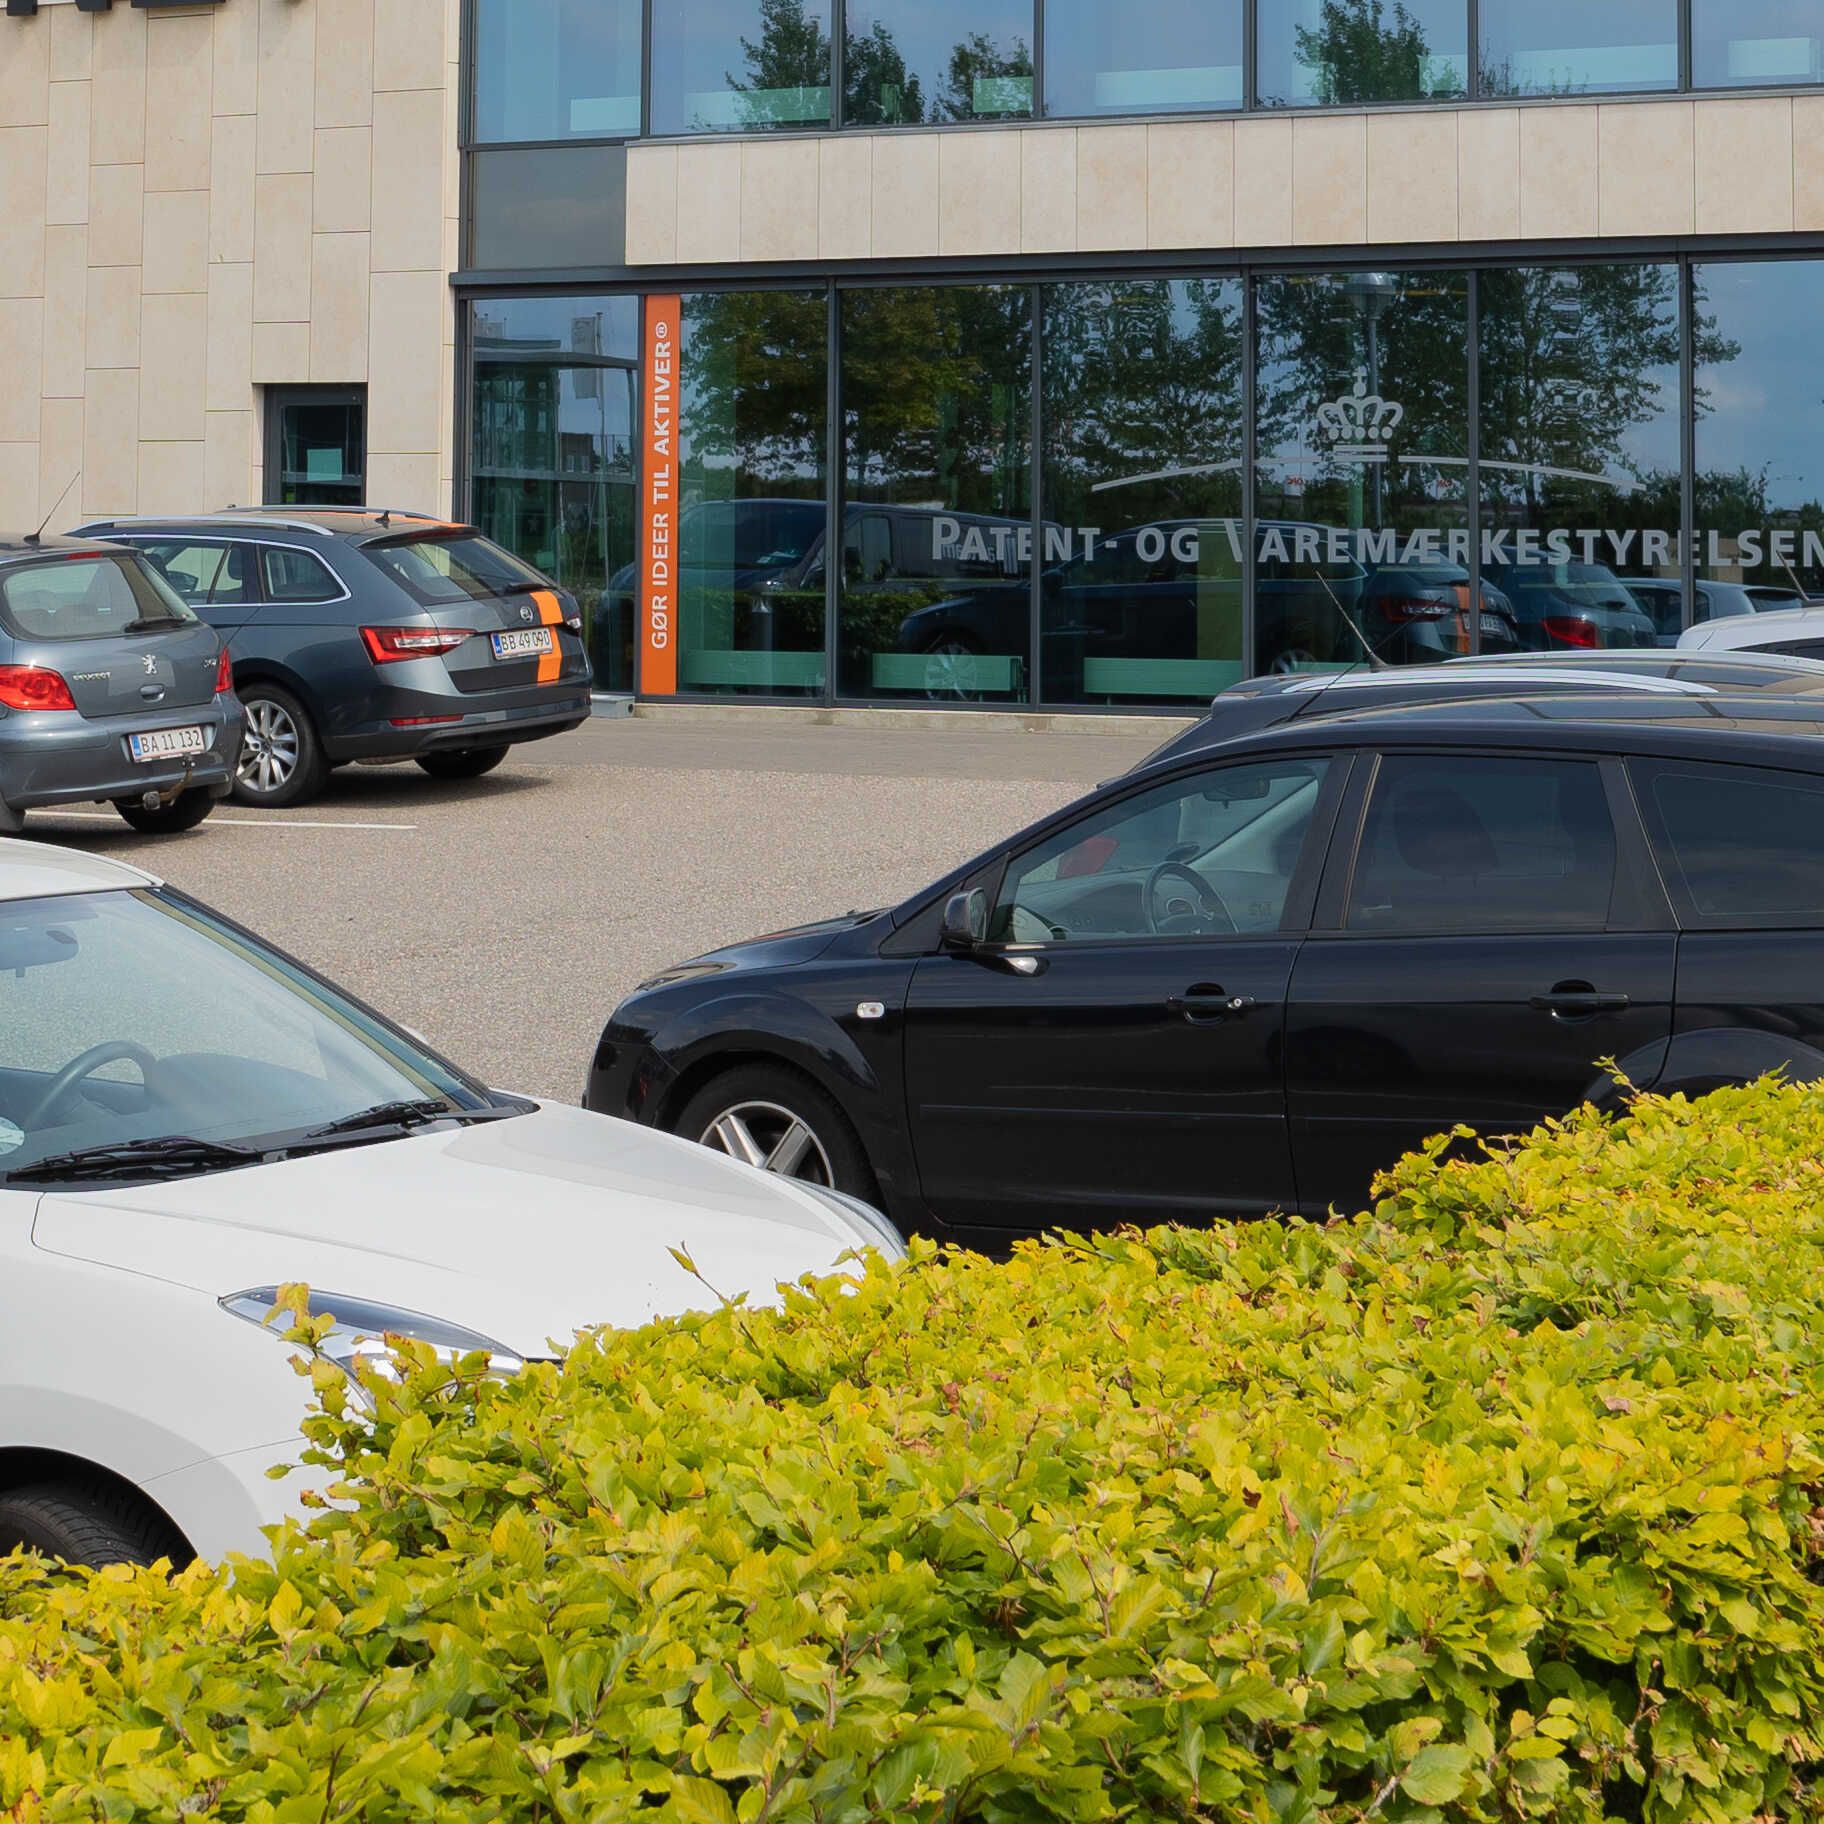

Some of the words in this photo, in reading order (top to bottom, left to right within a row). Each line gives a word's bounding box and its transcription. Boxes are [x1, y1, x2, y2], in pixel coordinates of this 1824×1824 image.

[653, 463, 669, 505] TIL
[653, 513, 669, 586] IDEER
[501, 634, 516, 650] BB
[519, 632, 531, 648] 49
[651, 595, 668, 649] GØR
[140, 738, 160, 753] BA
[163, 734, 176, 750] 11
[181, 730, 201, 748] 132
